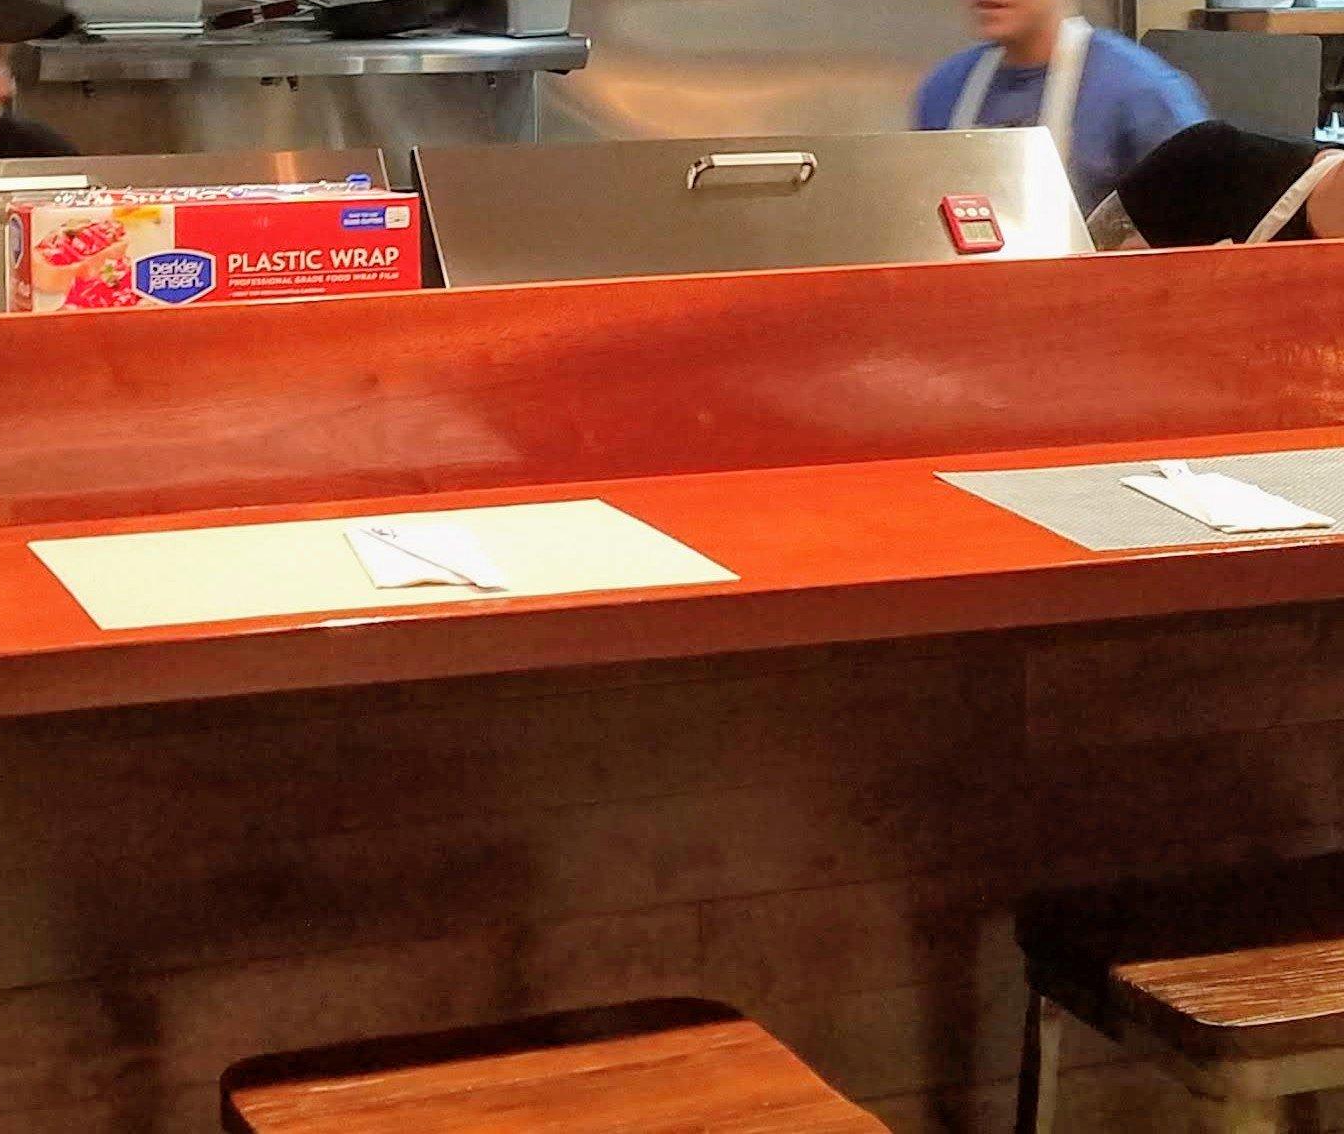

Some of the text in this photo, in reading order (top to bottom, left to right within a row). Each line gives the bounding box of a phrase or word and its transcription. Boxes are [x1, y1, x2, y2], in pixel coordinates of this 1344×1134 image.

[148, 259, 204, 278] berkley
[227, 246, 401, 273] PLASTIC WRAP
